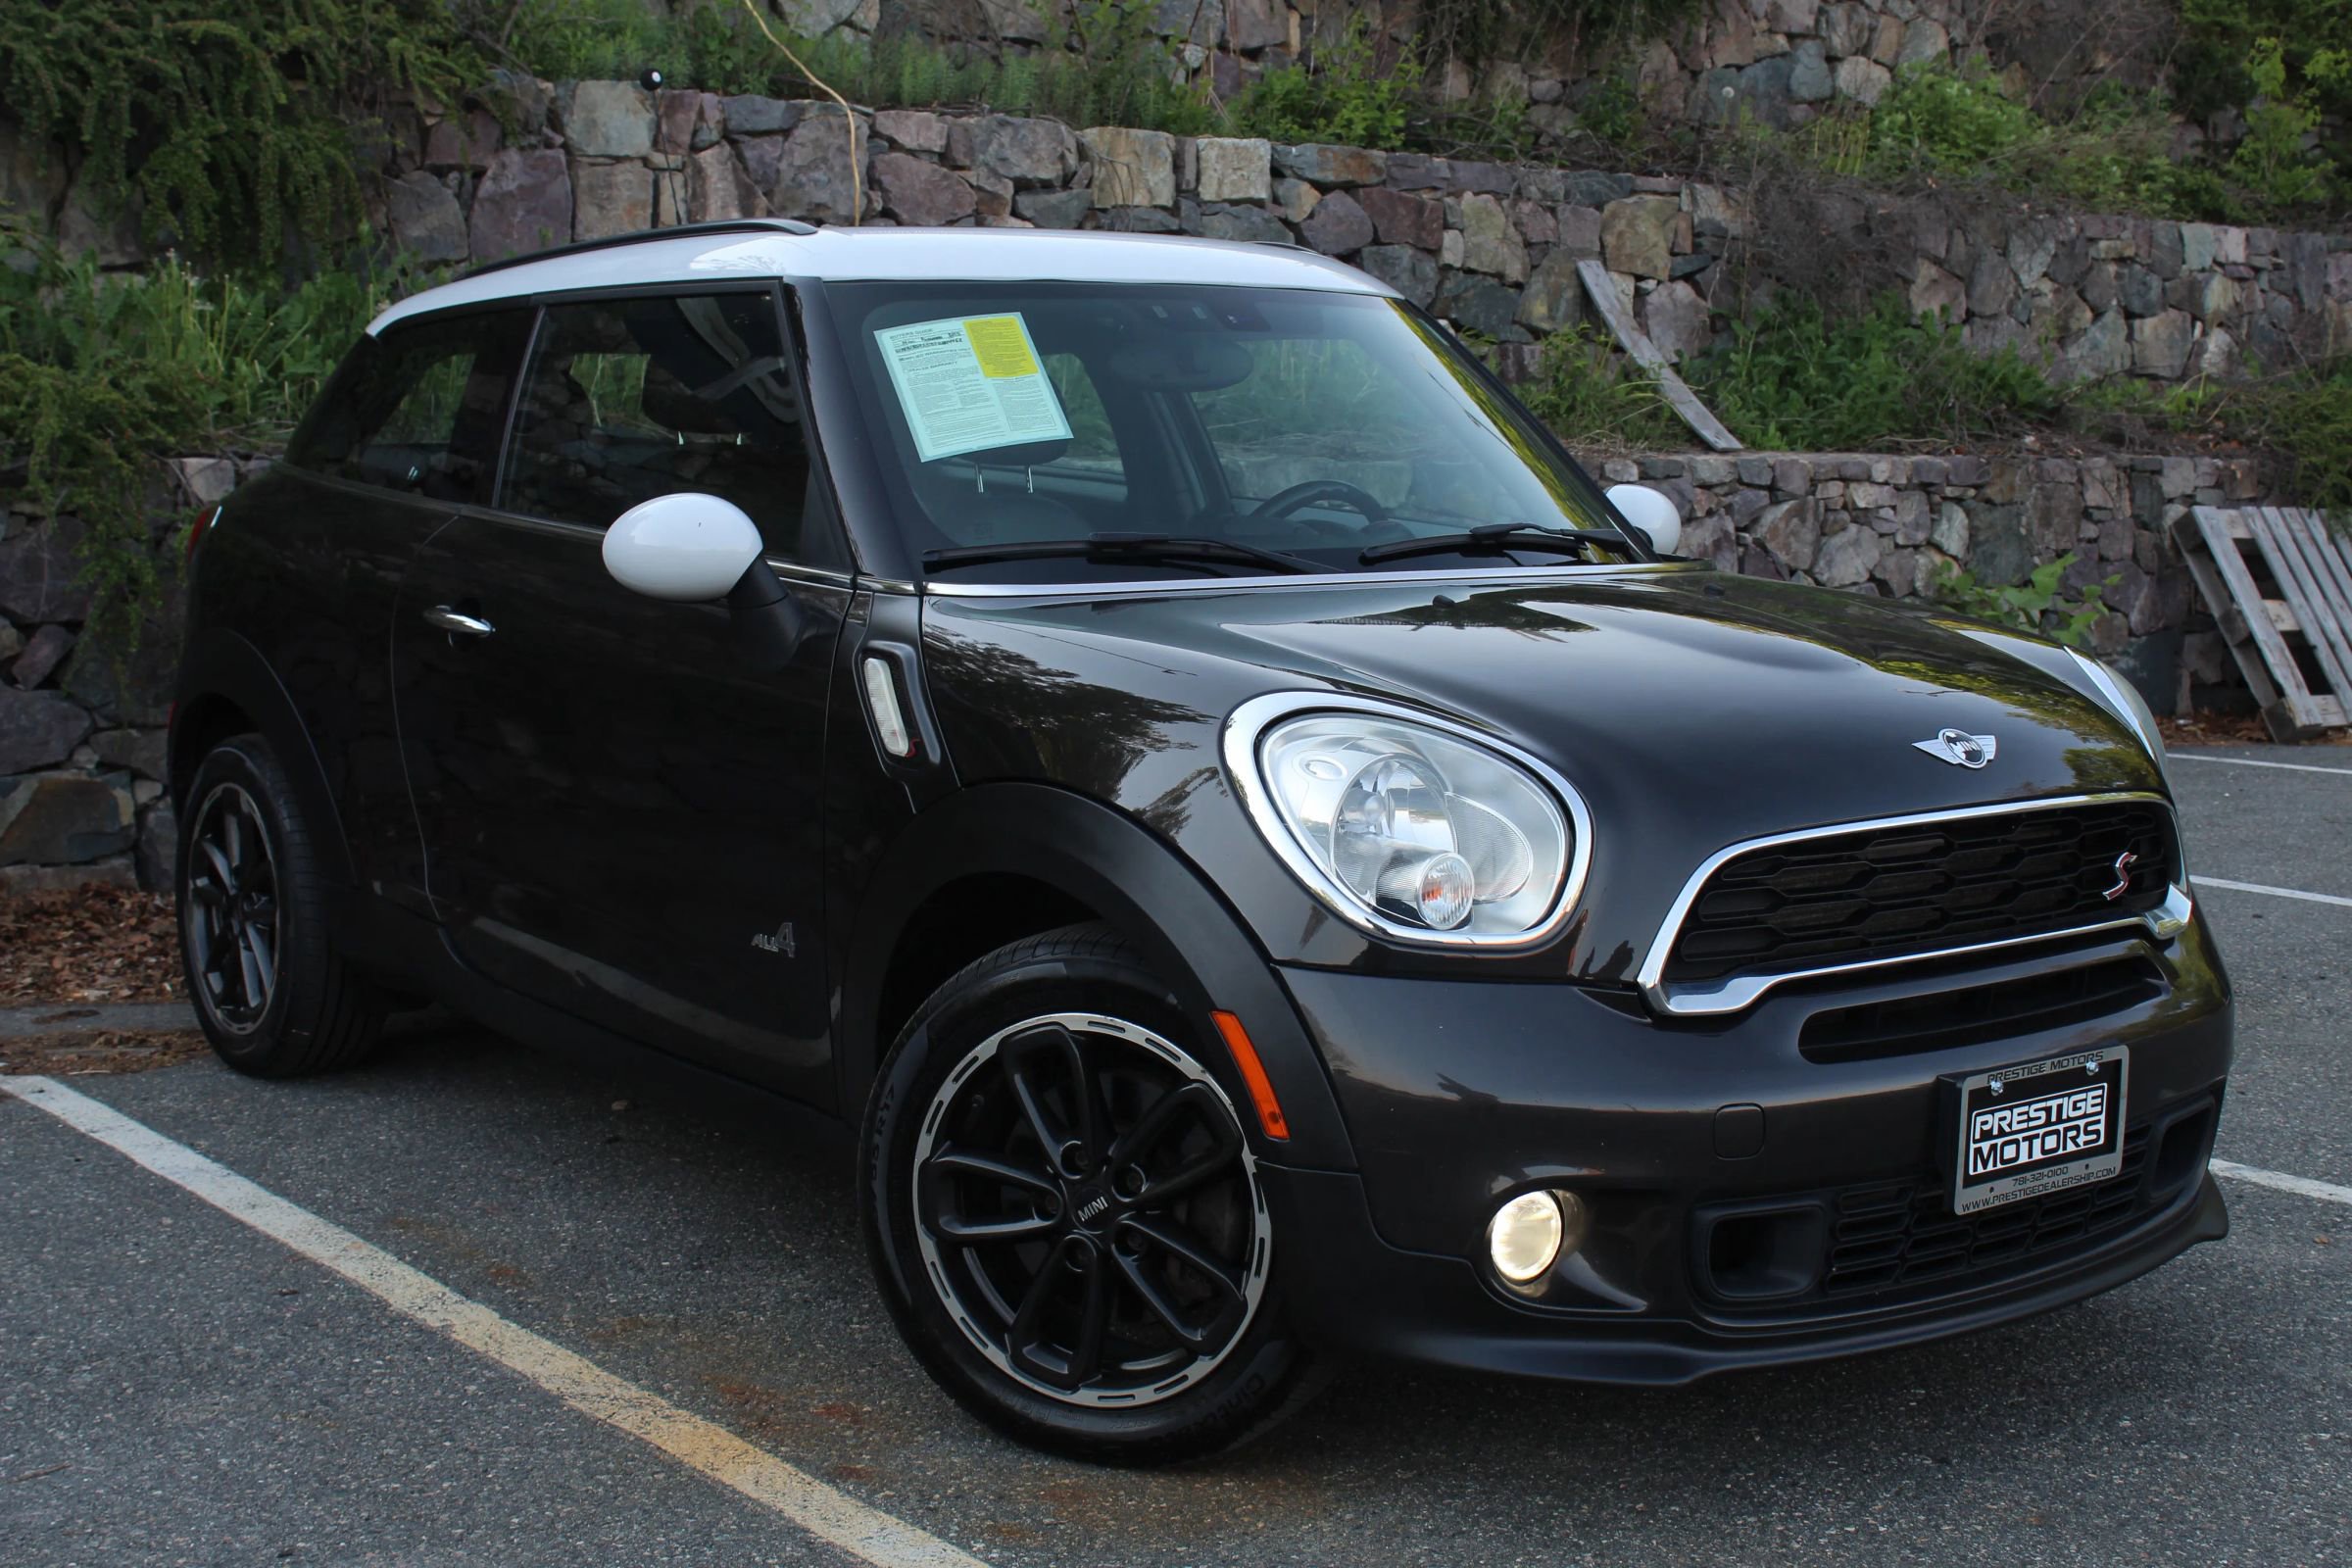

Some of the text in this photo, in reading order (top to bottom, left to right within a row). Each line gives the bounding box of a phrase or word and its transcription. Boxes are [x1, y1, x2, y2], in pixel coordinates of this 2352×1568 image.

[2102, 852, 2138, 901] S
[1986, 1052, 2104, 1085] PRESTIGE MOTORS
[1974, 1089, 2103, 1141] PRESTIGE
[1972, 1118, 2102, 1173] MOTORS
[1962, 1166, 2116, 1213] WWW.PRESTIGEDEALERSHIP.COM
[2012, 1165, 2069, 1188] 781-321-0100
[1077, 1196, 1108, 1222] MINI
